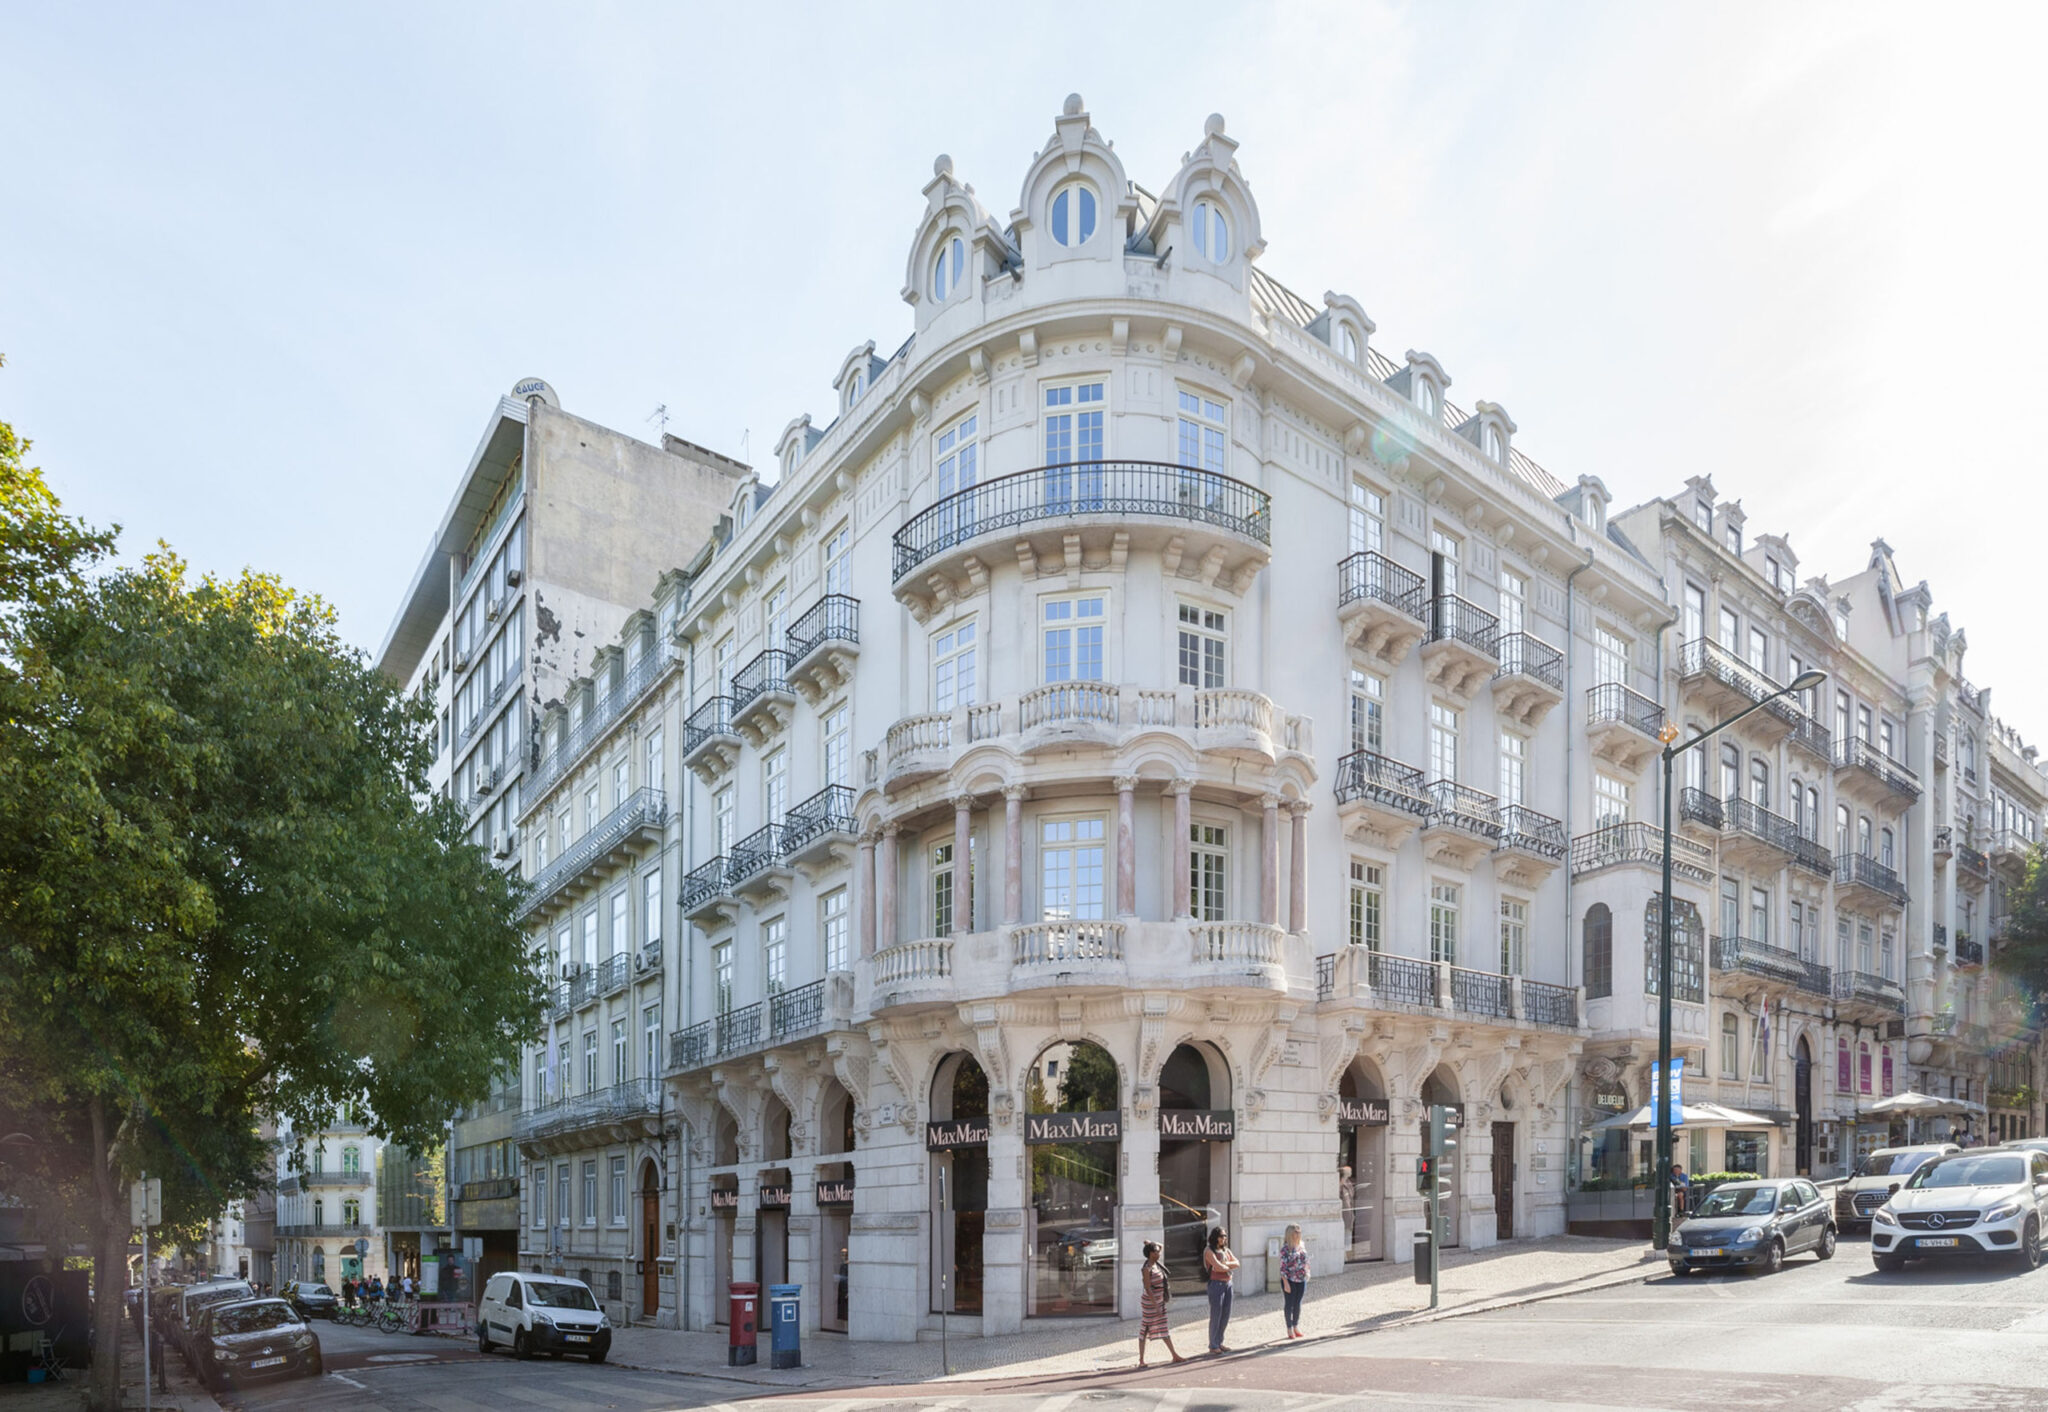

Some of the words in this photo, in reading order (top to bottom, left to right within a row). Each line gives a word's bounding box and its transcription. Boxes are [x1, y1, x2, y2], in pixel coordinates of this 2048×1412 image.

[1340, 1102, 1387, 1121] MaxMara
[1422, 1106, 1462, 1123] Mara
[1029, 1117, 1118, 1139] MaxMara
[1161, 1114, 1232, 1135] MaxMara
[929, 1123, 988, 1146] MaxMara
[713, 1192, 737, 1207] MaxMar
[761, 1188, 791, 1205] MaxMar
